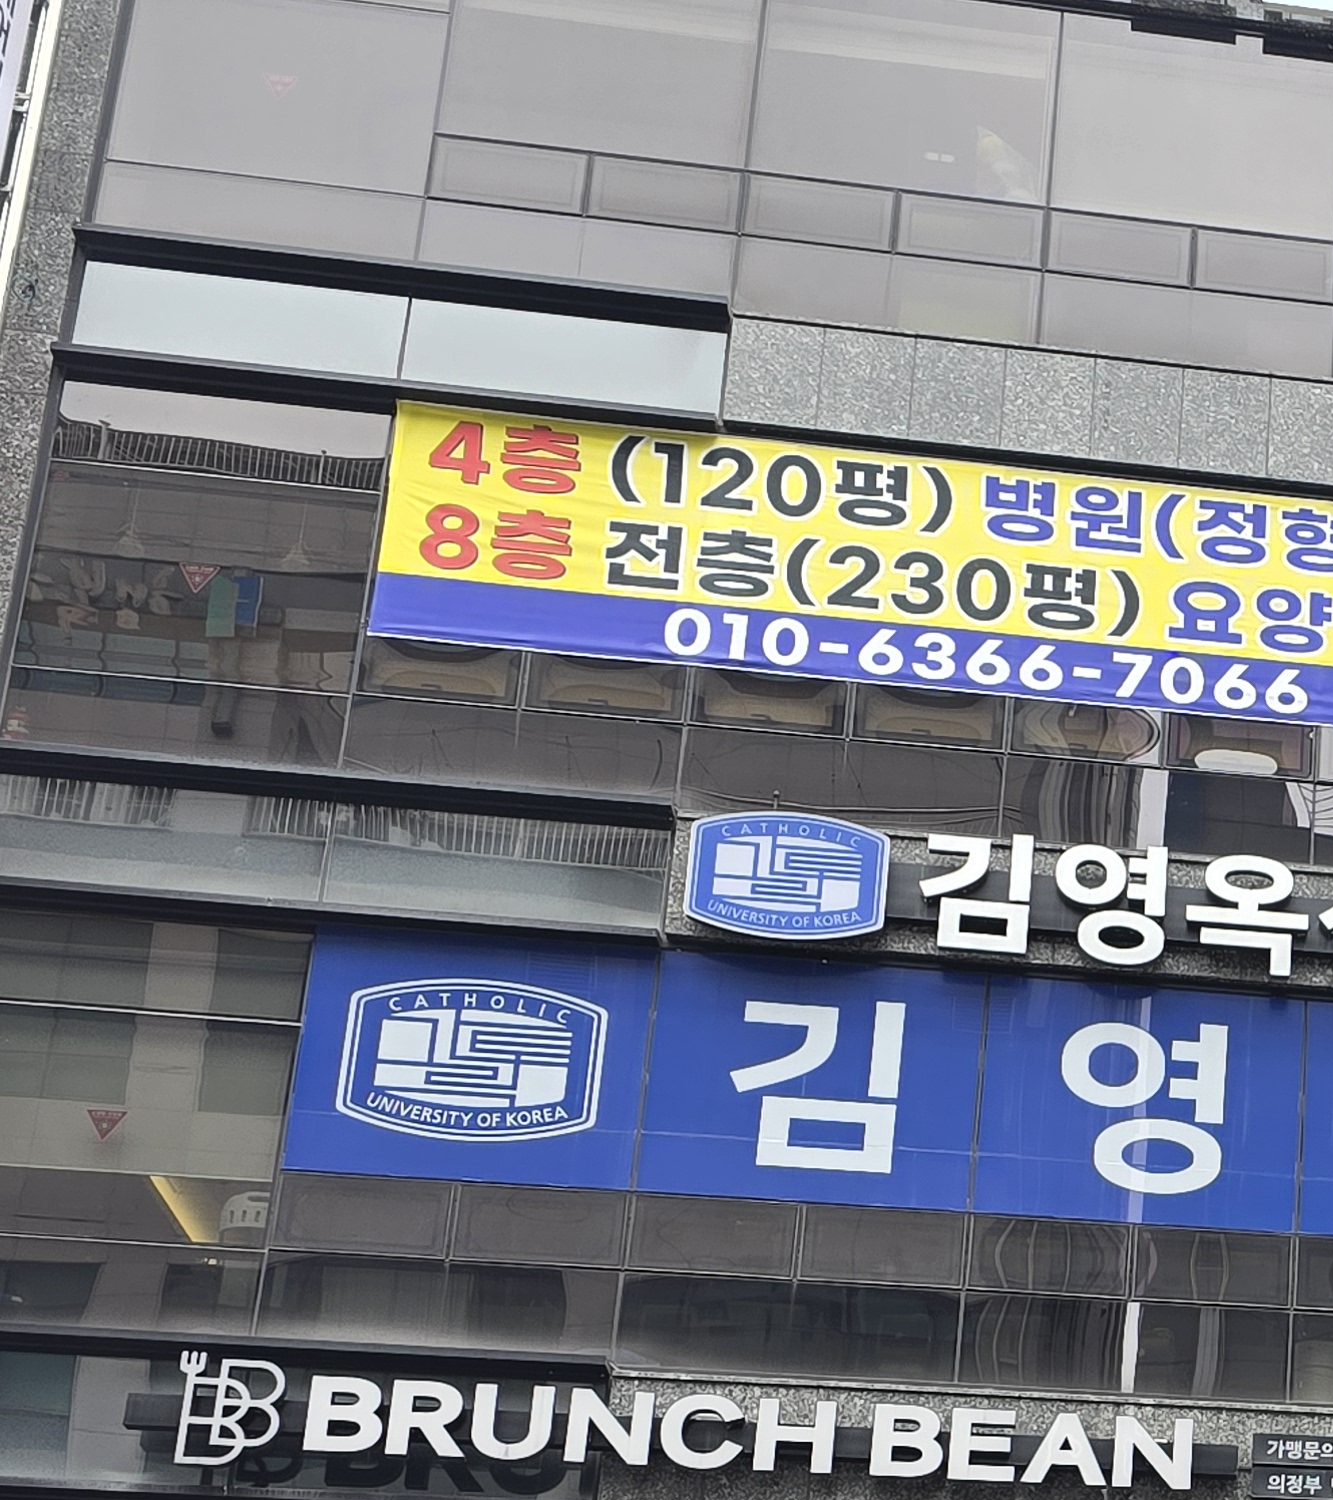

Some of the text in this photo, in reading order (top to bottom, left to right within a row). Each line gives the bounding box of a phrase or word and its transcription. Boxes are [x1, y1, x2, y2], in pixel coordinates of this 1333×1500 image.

[429, 420, 583, 496] 4층
[609, 435, 953, 533] (120평)
[418, 502, 573, 580] 8층
[604, 516, 1141, 637] 전층(230평)
[664, 606, 1310, 716] 010-6366-7066
[721, 820, 863, 850] CATHOLIC
[706, 898, 863, 930] UNIVERSITY OF KOREA
[388, 992, 573, 1025] CATHOLIC
[365, 1093, 570, 1130] UNIVERSITY OF KOREA
[303, 1374, 1195, 1491] BRUNCH BEAN
[1266, 1474, 1322, 1496] 의정부
